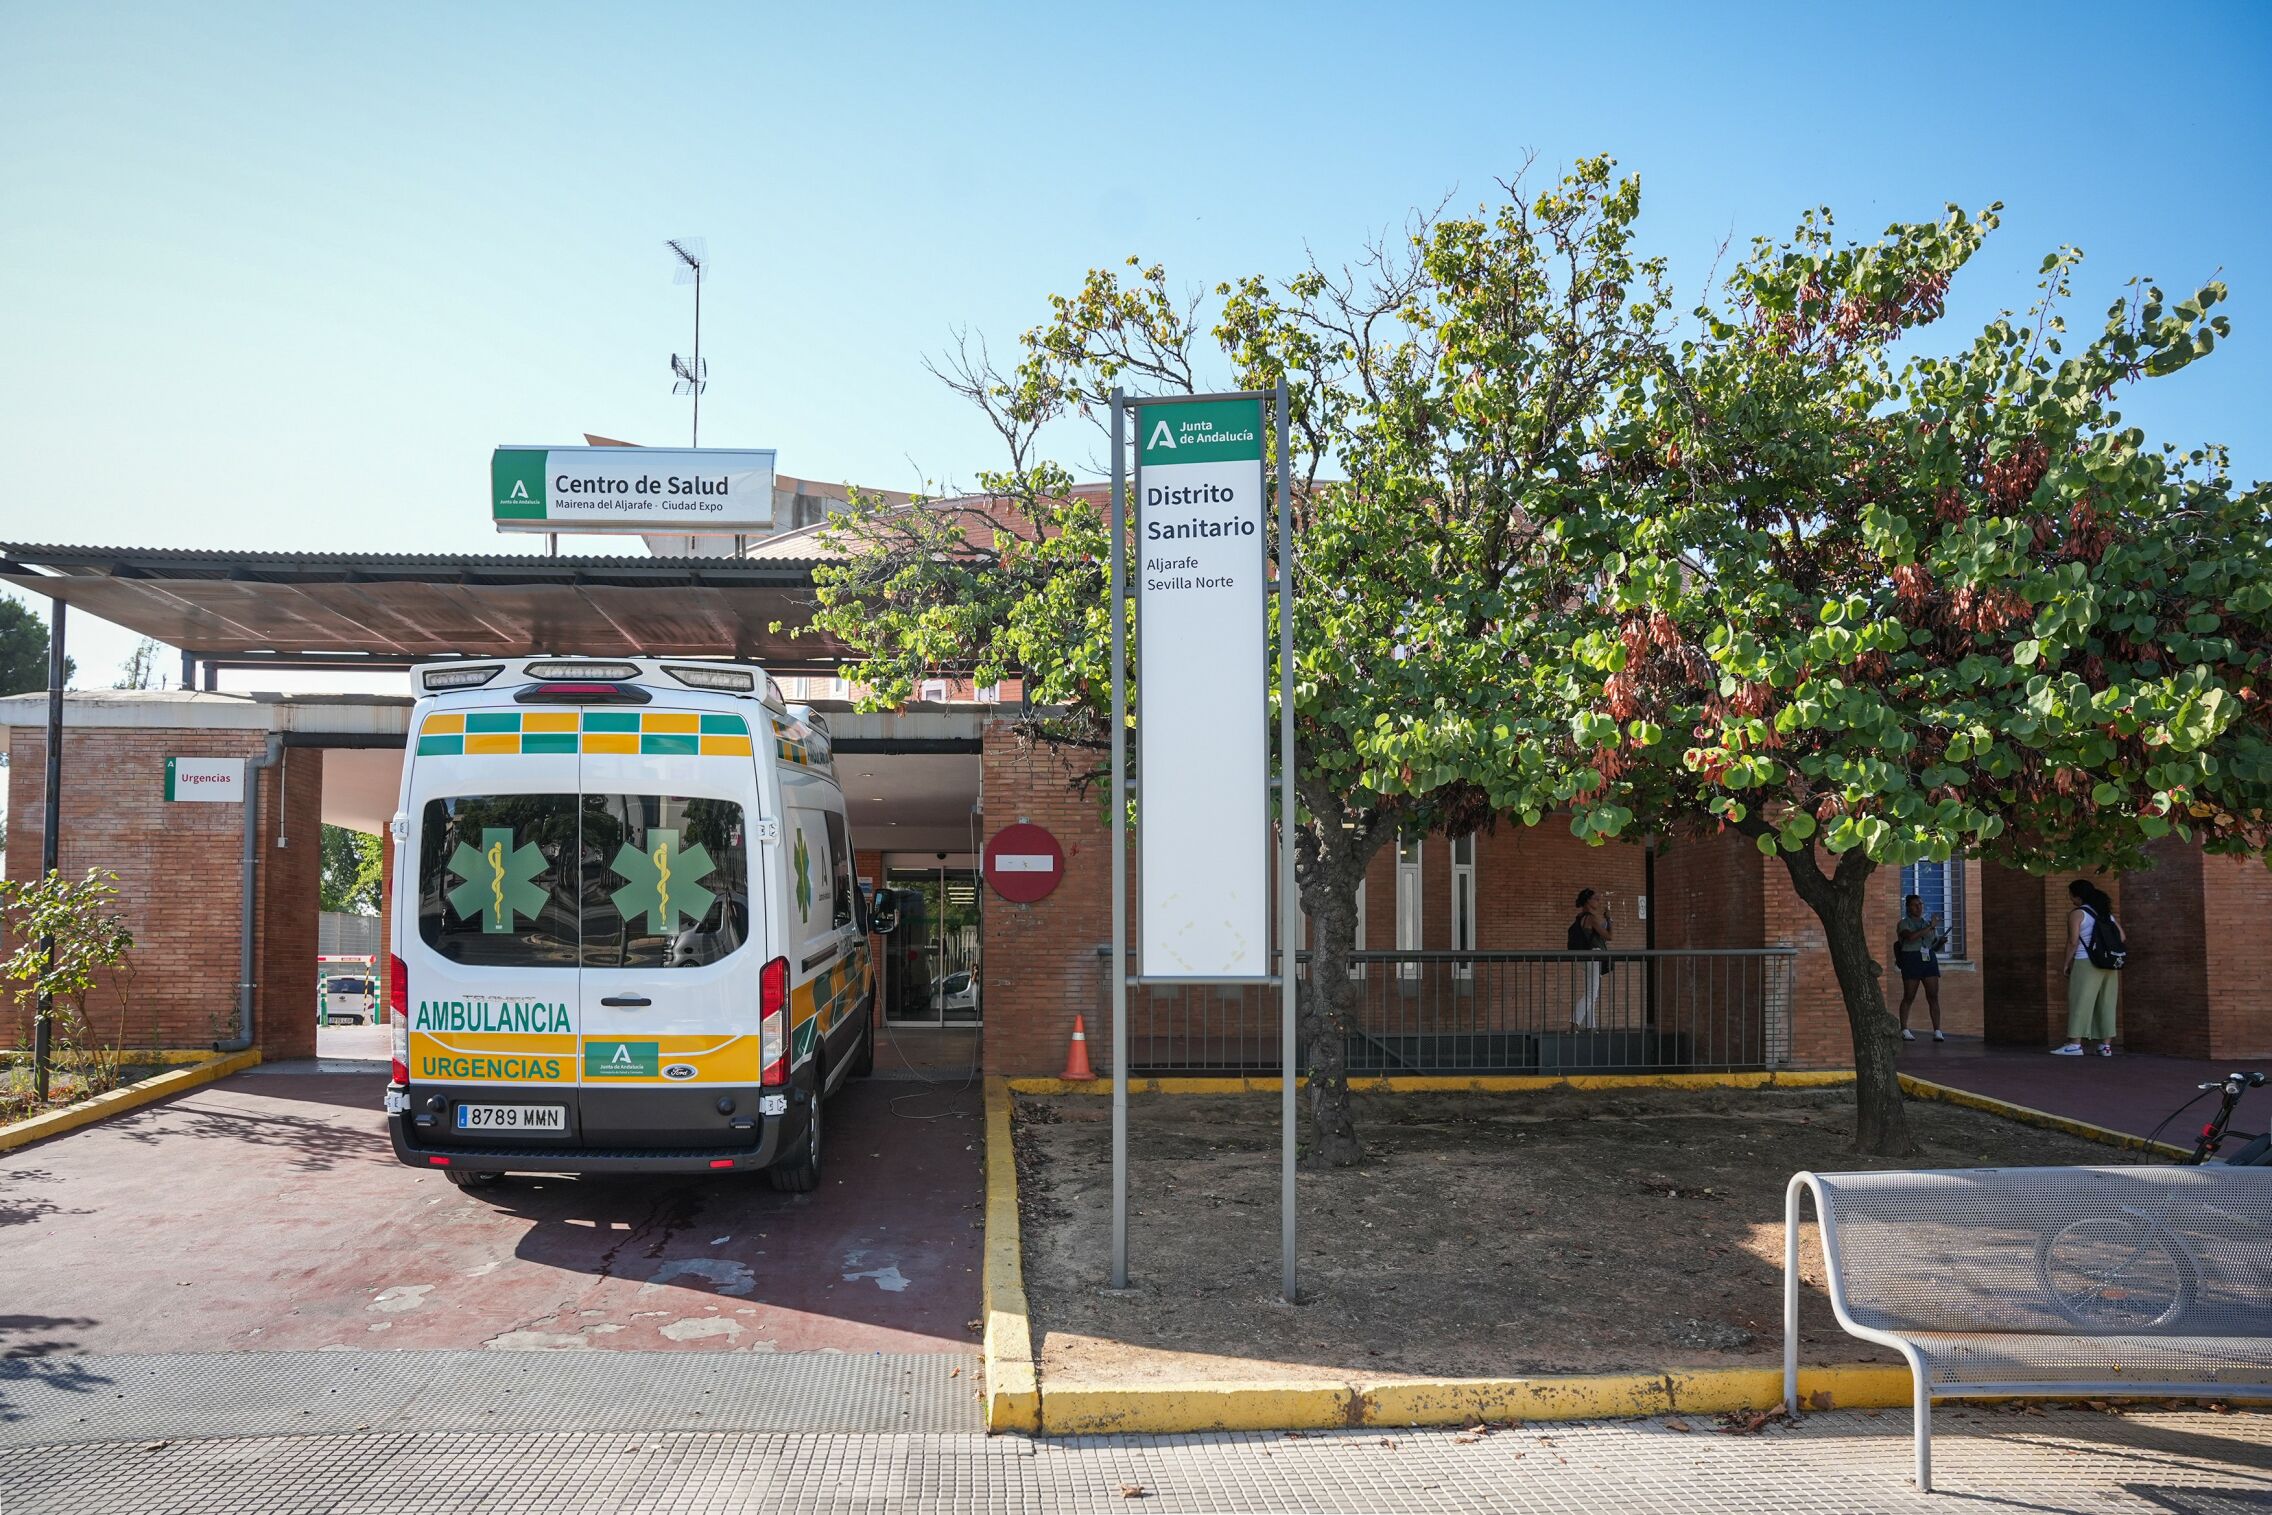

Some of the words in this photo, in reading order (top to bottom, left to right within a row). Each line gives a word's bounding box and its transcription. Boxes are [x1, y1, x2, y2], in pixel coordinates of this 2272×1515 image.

[1180, 421, 1213, 432] Junta
[1180, 435, 1194, 444] de
[1197, 429, 1253, 443] Andalucía
[556, 475, 629, 494] Centro
[635, 475, 661, 494] de
[668, 476, 729, 495] Salud
[1148, 483, 1234, 506] Distrito
[555, 500, 595, 509] Mairena
[597, 500, 612, 509] del
[614, 500, 653, 512] Aljarafe
[662, 501, 697, 510] Ciudad
[699, 502, 723, 513] Expo
[1148, 516, 1255, 541] Sanitario
[1147, 557, 1198, 573] Aljarafe
[1147, 577, 1192, 591] Sevilla
[1196, 576, 1234, 589] Norte
[182, 774, 231, 784] Urgencias
[416, 1001, 571, 1033] AMBULANCIA
[423, 1057, 560, 1079] URGENCIAS
[472, 1108, 517, 1126] 8789
[524, 1109, 558, 1126] MMN
